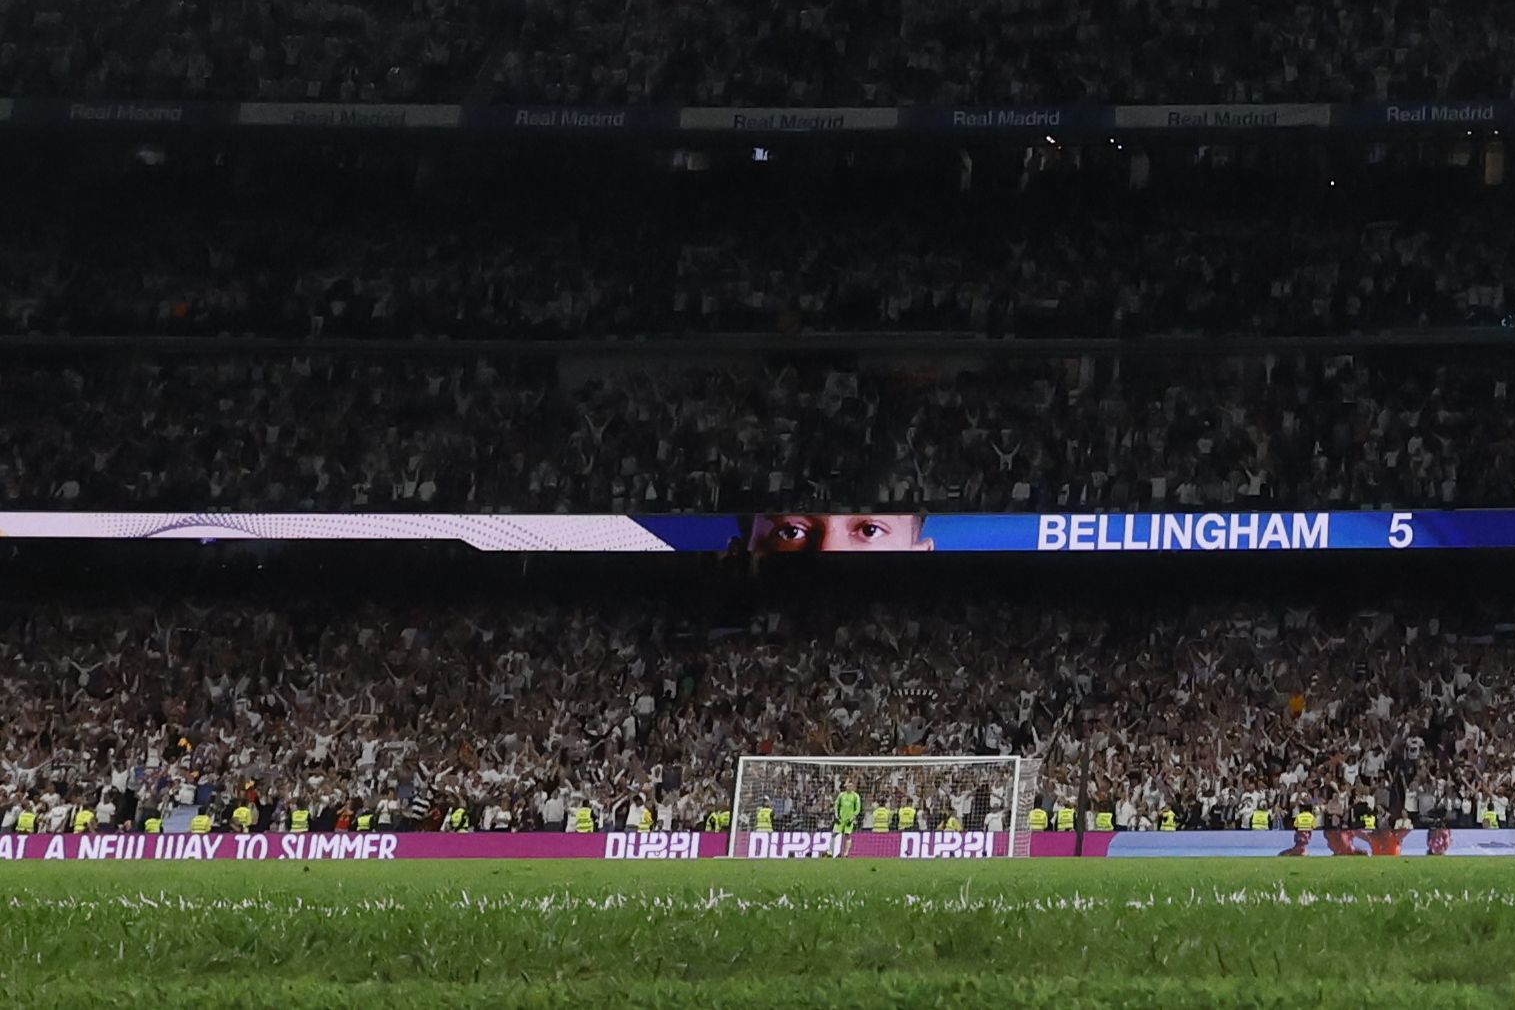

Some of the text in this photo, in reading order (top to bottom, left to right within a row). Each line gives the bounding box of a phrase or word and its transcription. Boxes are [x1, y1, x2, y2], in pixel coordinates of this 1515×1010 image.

[70, 103, 183, 121] Real Madrid
[515, 109, 625, 127] Real Madrid
[953, 109, 1060, 126] Real Madrid
[1168, 111, 1208, 127] Real
[1387, 104, 1494, 122] Real Madrid
[733, 114, 844, 130] Real Madrid
[1037, 512, 1414, 550] BELLINGHAM 5
[44, 834, 65, 859] A
[78, 834, 146, 859] NEW
[155, 834, 222, 859] WAY
[235, 834, 268, 859] TO
[279, 834, 398, 859] SUMMER
[605, 832, 699, 858] DUBAI
[901, 831, 994, 858] DUBAI
